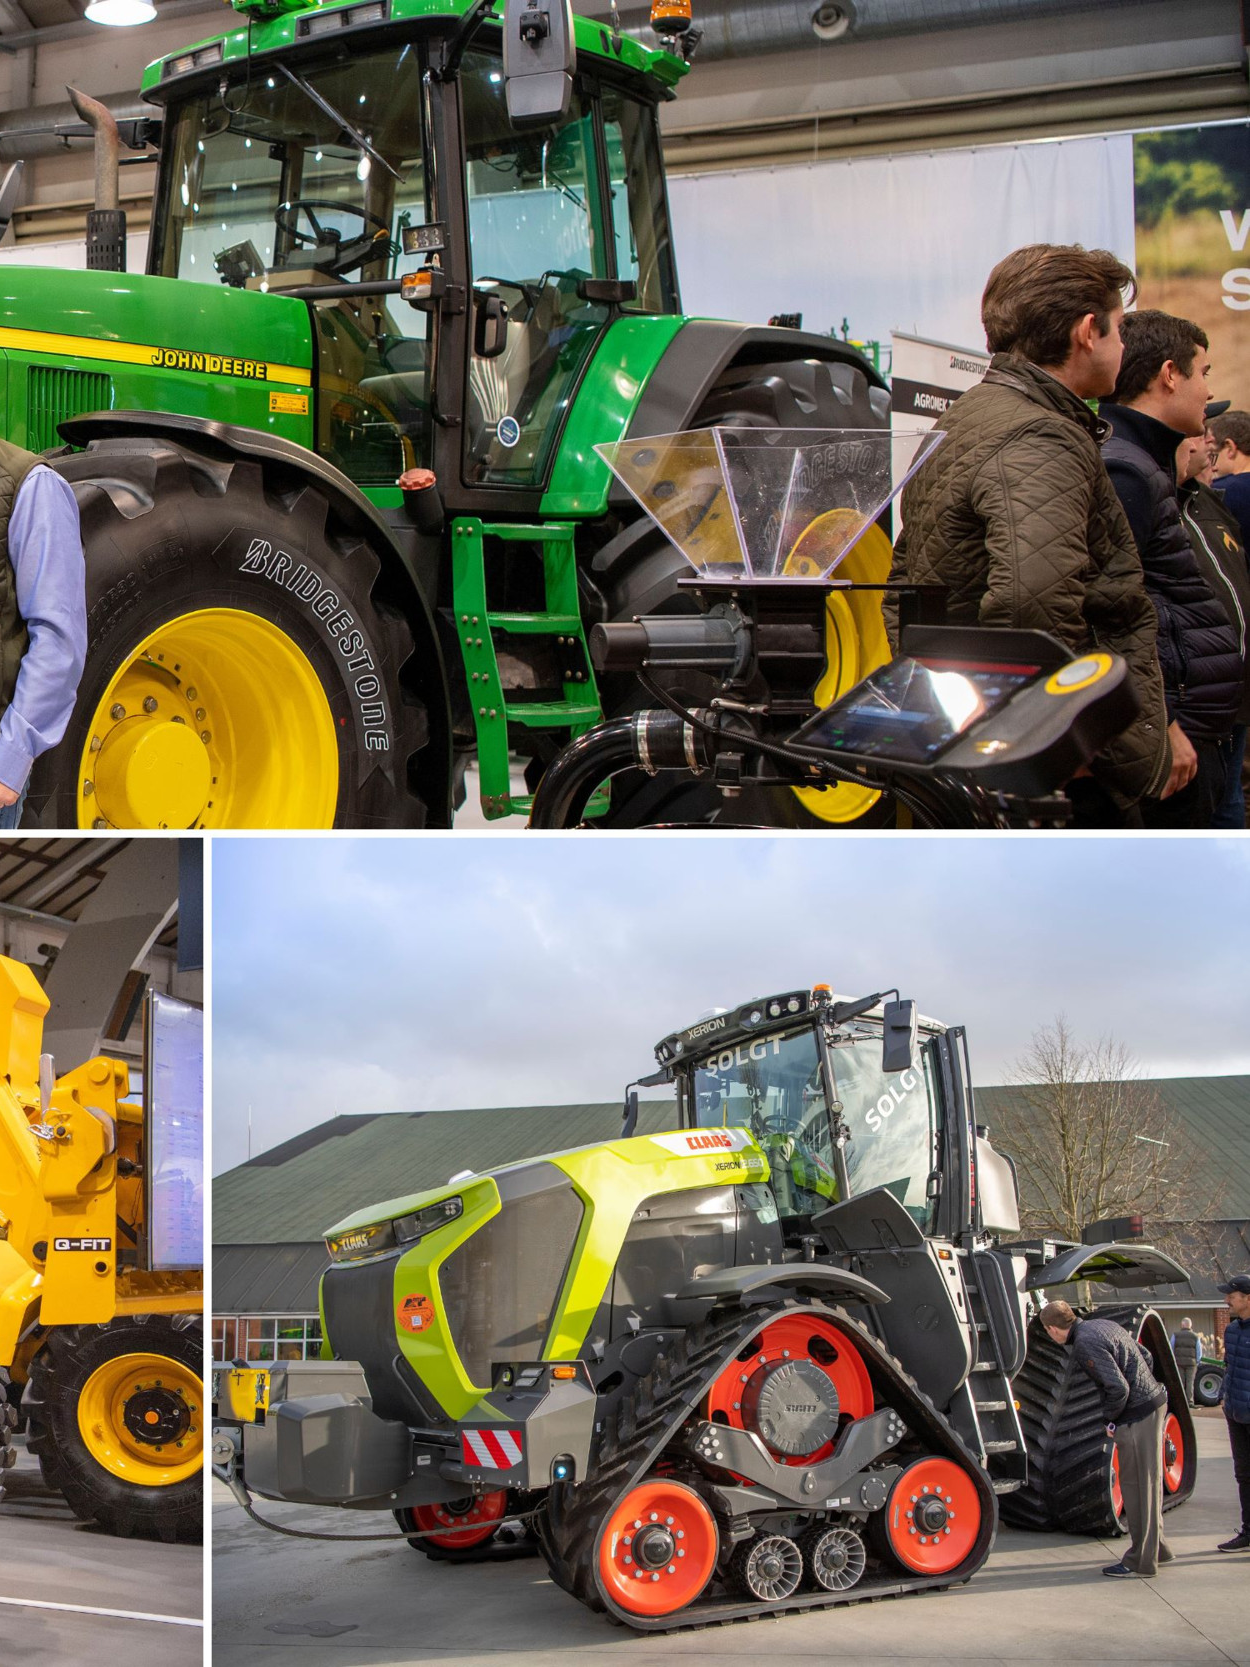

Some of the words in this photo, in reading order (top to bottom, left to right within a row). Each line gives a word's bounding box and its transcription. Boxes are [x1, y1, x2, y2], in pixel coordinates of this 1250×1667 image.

[151, 348, 205, 371] JOHN
[209, 355, 267, 379] DEERE
[914, 392, 948, 412] AGROMEK
[238, 538, 390, 751] BRIDGESTONE
[687, 1017, 726, 1040] XERION
[704, 1032, 786, 1079] SOLGT
[865, 1056, 924, 1133] SOLGT
[686, 1135, 732, 1150] CLAAS
[715, 1161, 741, 1171] XERION
[54, 1238, 111, 1251] Q-FIT
[342, 1233, 369, 1251] CLAAS
